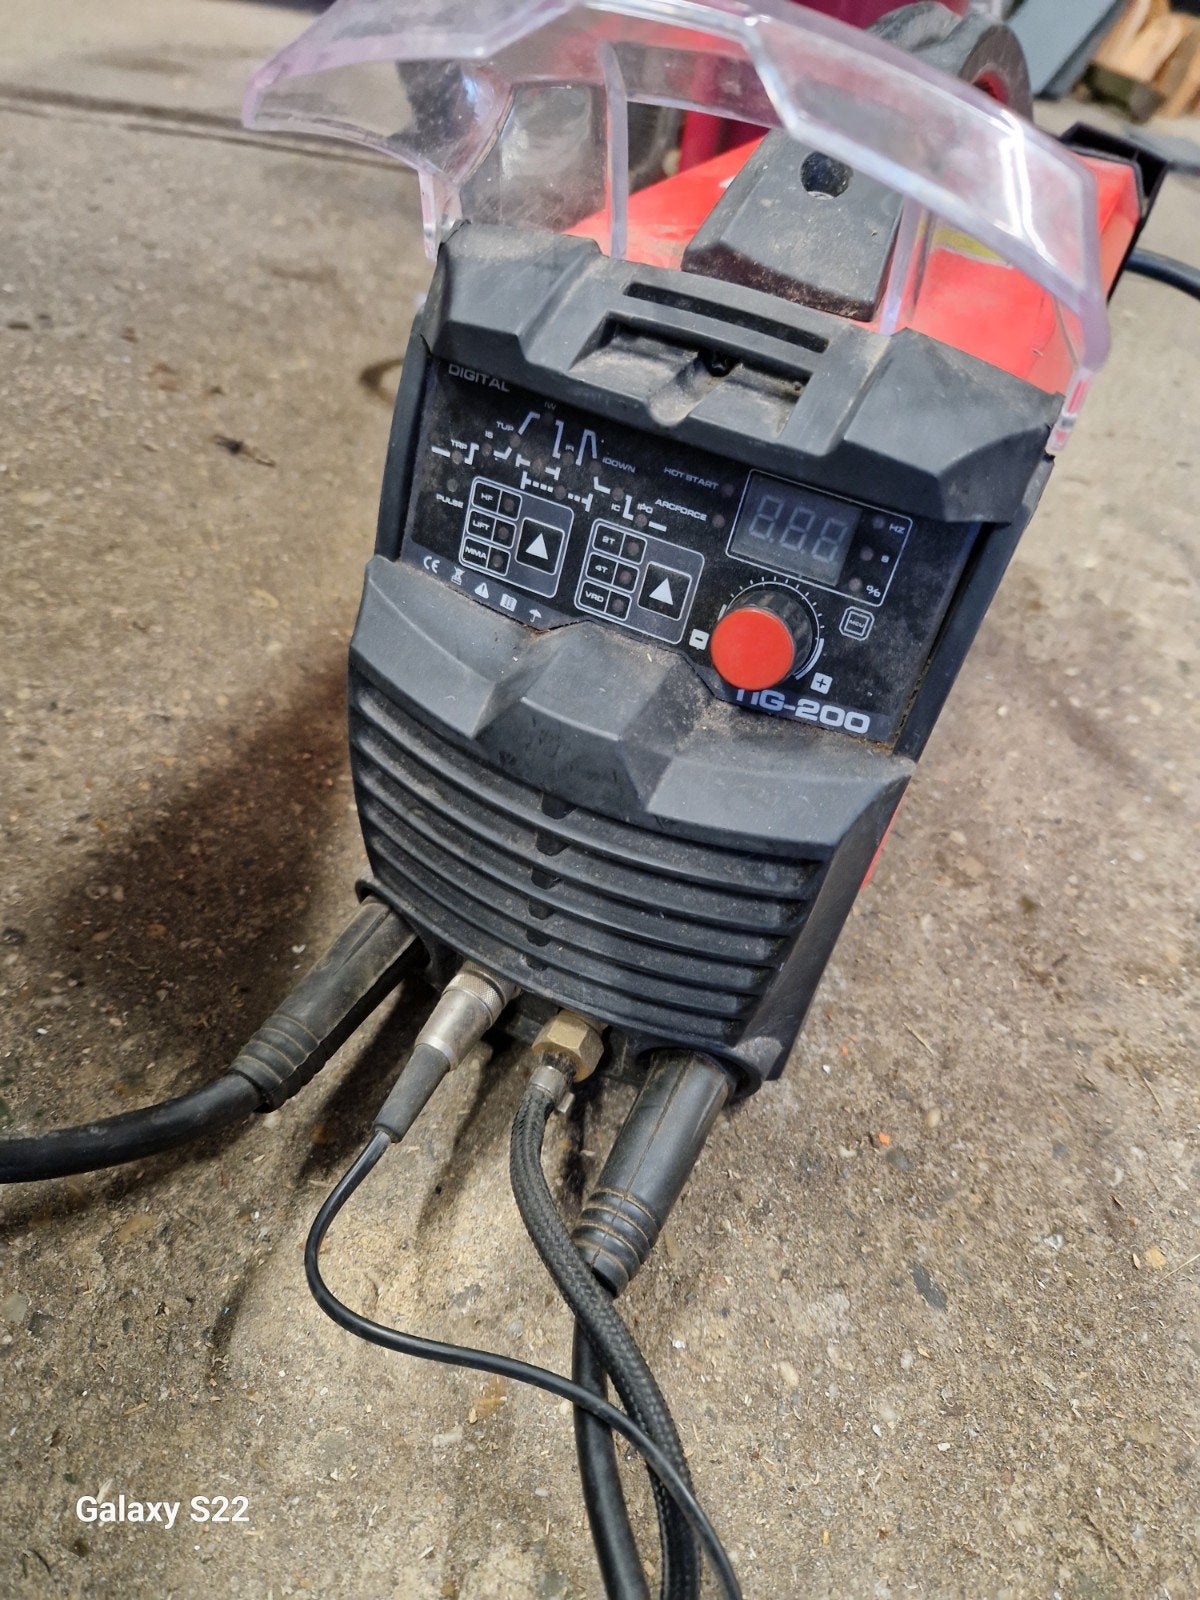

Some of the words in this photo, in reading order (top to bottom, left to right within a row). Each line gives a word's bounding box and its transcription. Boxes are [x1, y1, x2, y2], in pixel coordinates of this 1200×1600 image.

[448, 363, 511, 393] DIGITAL
[663, 466, 684, 478] HOT
[685, 474, 719, 490] START
[435, 493, 464, 509] PULSE
[654, 498, 707, 522] ARCFORCE
[464, 546, 487, 560] MMA
[594, 564, 609, 574] 4T
[584, 590, 605, 604] VRD
